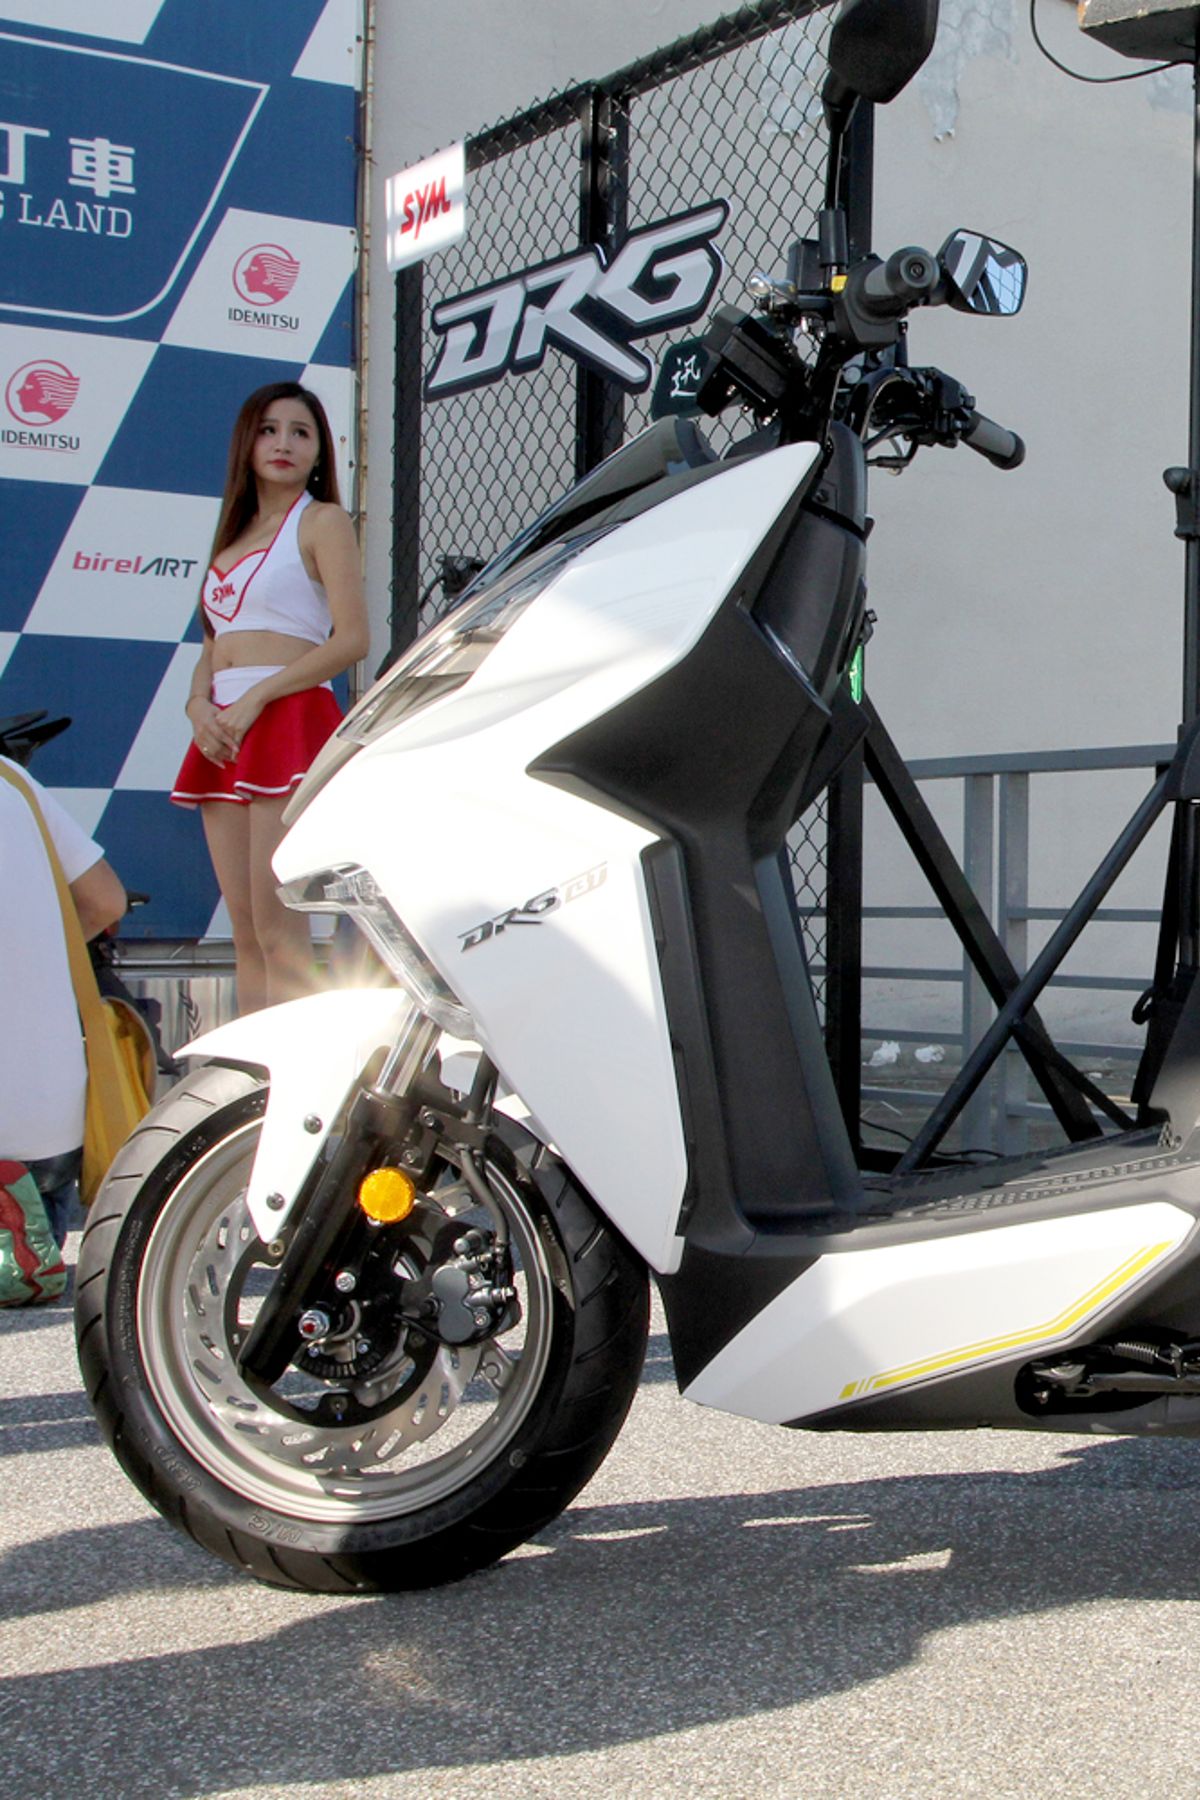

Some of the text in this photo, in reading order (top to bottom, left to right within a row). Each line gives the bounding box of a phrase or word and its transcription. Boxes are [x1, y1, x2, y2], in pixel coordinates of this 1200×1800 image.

[18, 193, 133, 238] LAND
[400, 176, 451, 240] SYM
[424, 198, 731, 401] DRG
[228, 308, 300, 330] IDEMITSU
[1, 430, 80, 450] IDEMITSU
[72, 551, 198, 578] birelART
[212, 583, 235, 604] SYM
